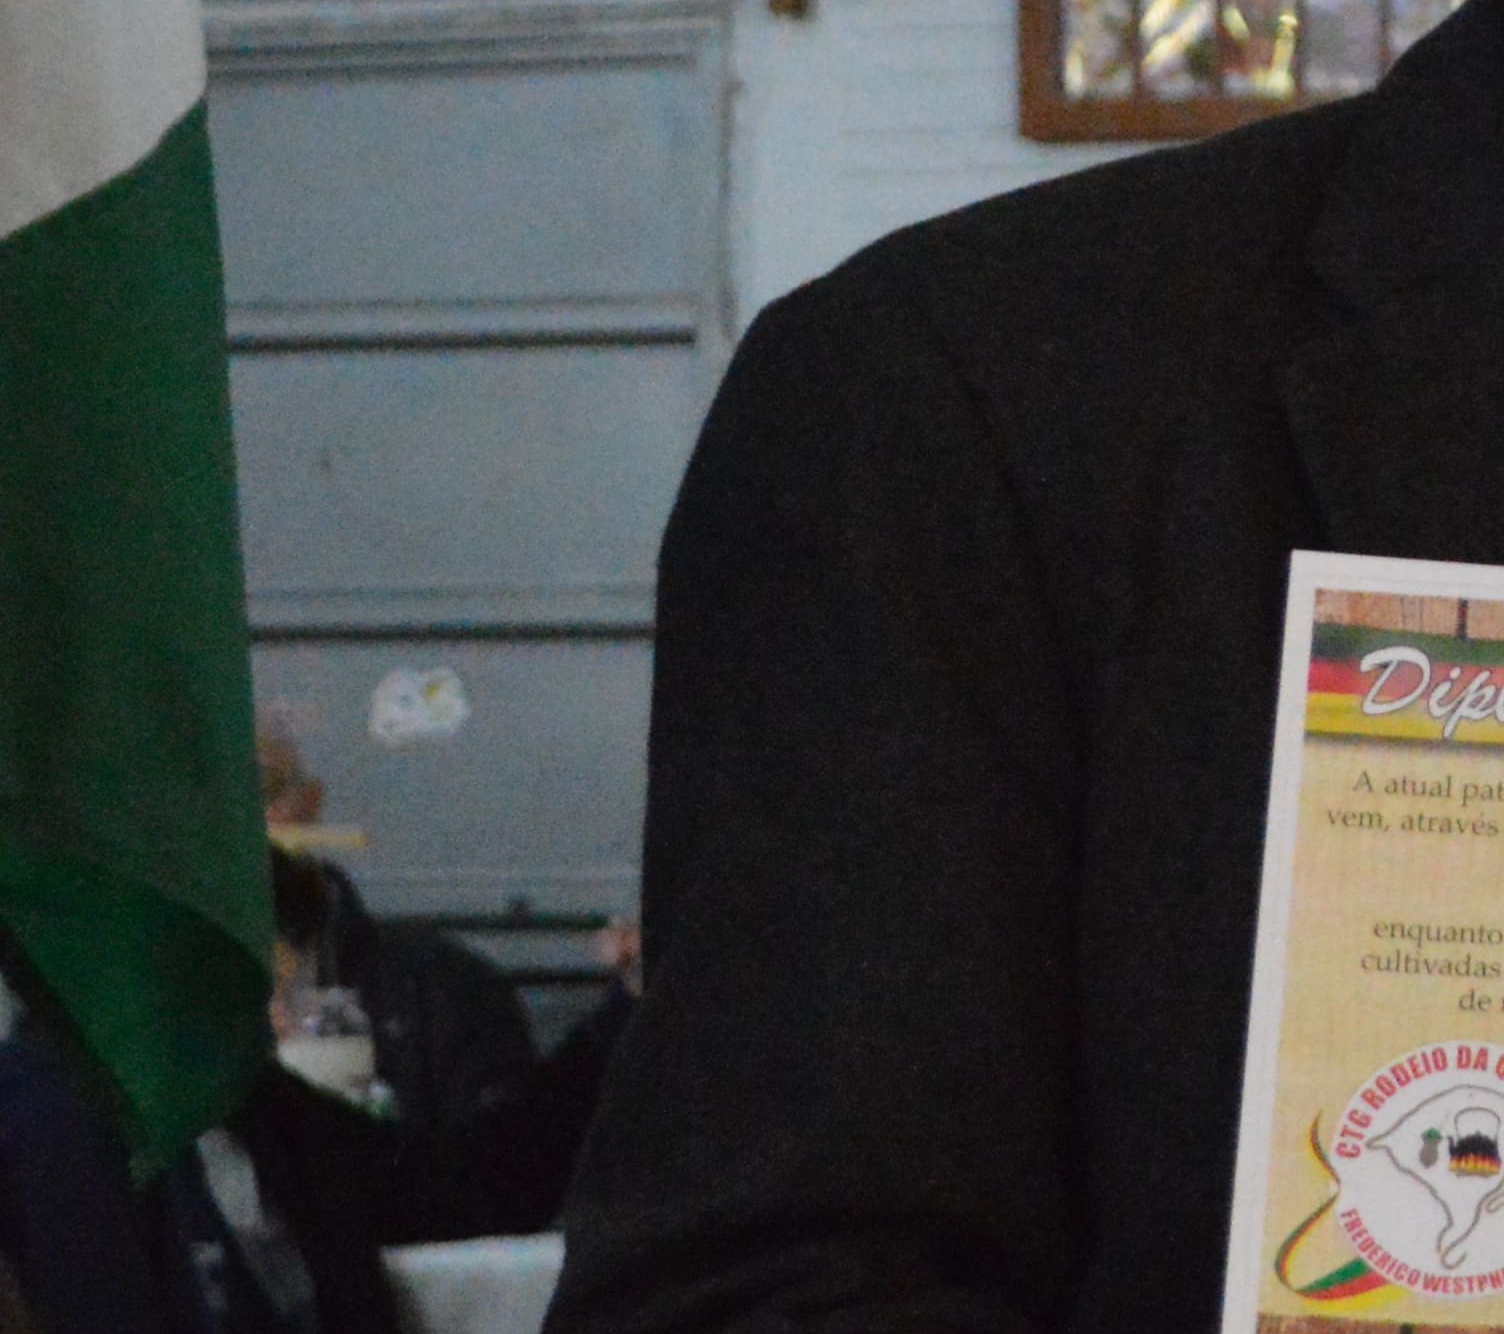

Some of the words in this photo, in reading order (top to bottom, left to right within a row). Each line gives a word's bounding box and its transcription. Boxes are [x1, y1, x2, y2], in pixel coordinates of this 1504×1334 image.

[1352, 771, 1375, 793] A
[1384, 774, 1452, 800] atual
[1325, 808, 1390, 834] vem,
[1401, 811, 1498, 837] através
[1373, 918, 1503, 949] enquanto
[1361, 949, 1501, 979] cultivadas
[1458, 987, 1493, 1013] de
[1335, 1107, 1374, 1160] CTG
[1360, 1046, 1449, 1110] RODEIO
[1456, 1045, 1490, 1072] DA
[1340, 1208, 1422, 1287] FREDERICO
